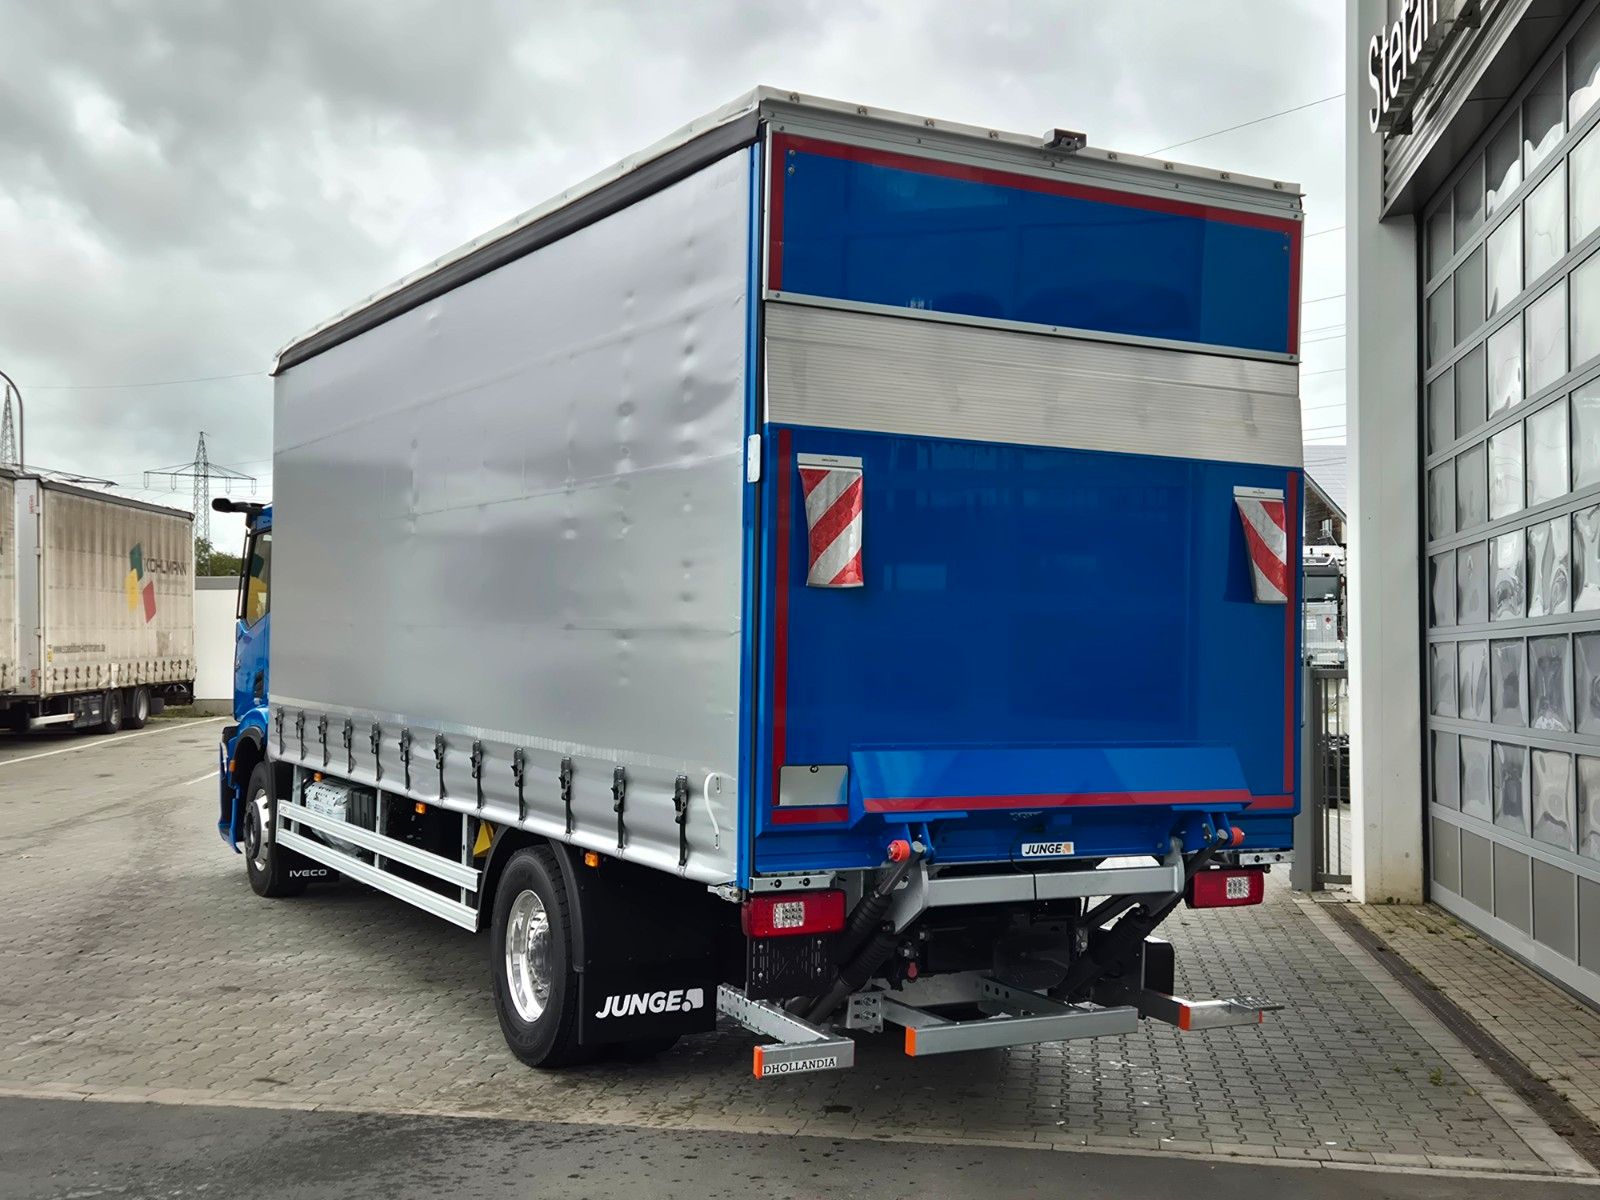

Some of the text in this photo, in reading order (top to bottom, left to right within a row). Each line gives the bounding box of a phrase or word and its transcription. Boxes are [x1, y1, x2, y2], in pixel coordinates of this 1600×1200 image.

[1025, 843, 1063, 855] JUNGE
[289, 869, 327, 878] IVECO
[595, 989, 684, 1019] JUNGE
[763, 1058, 836, 1075] DHOLLANDIA
